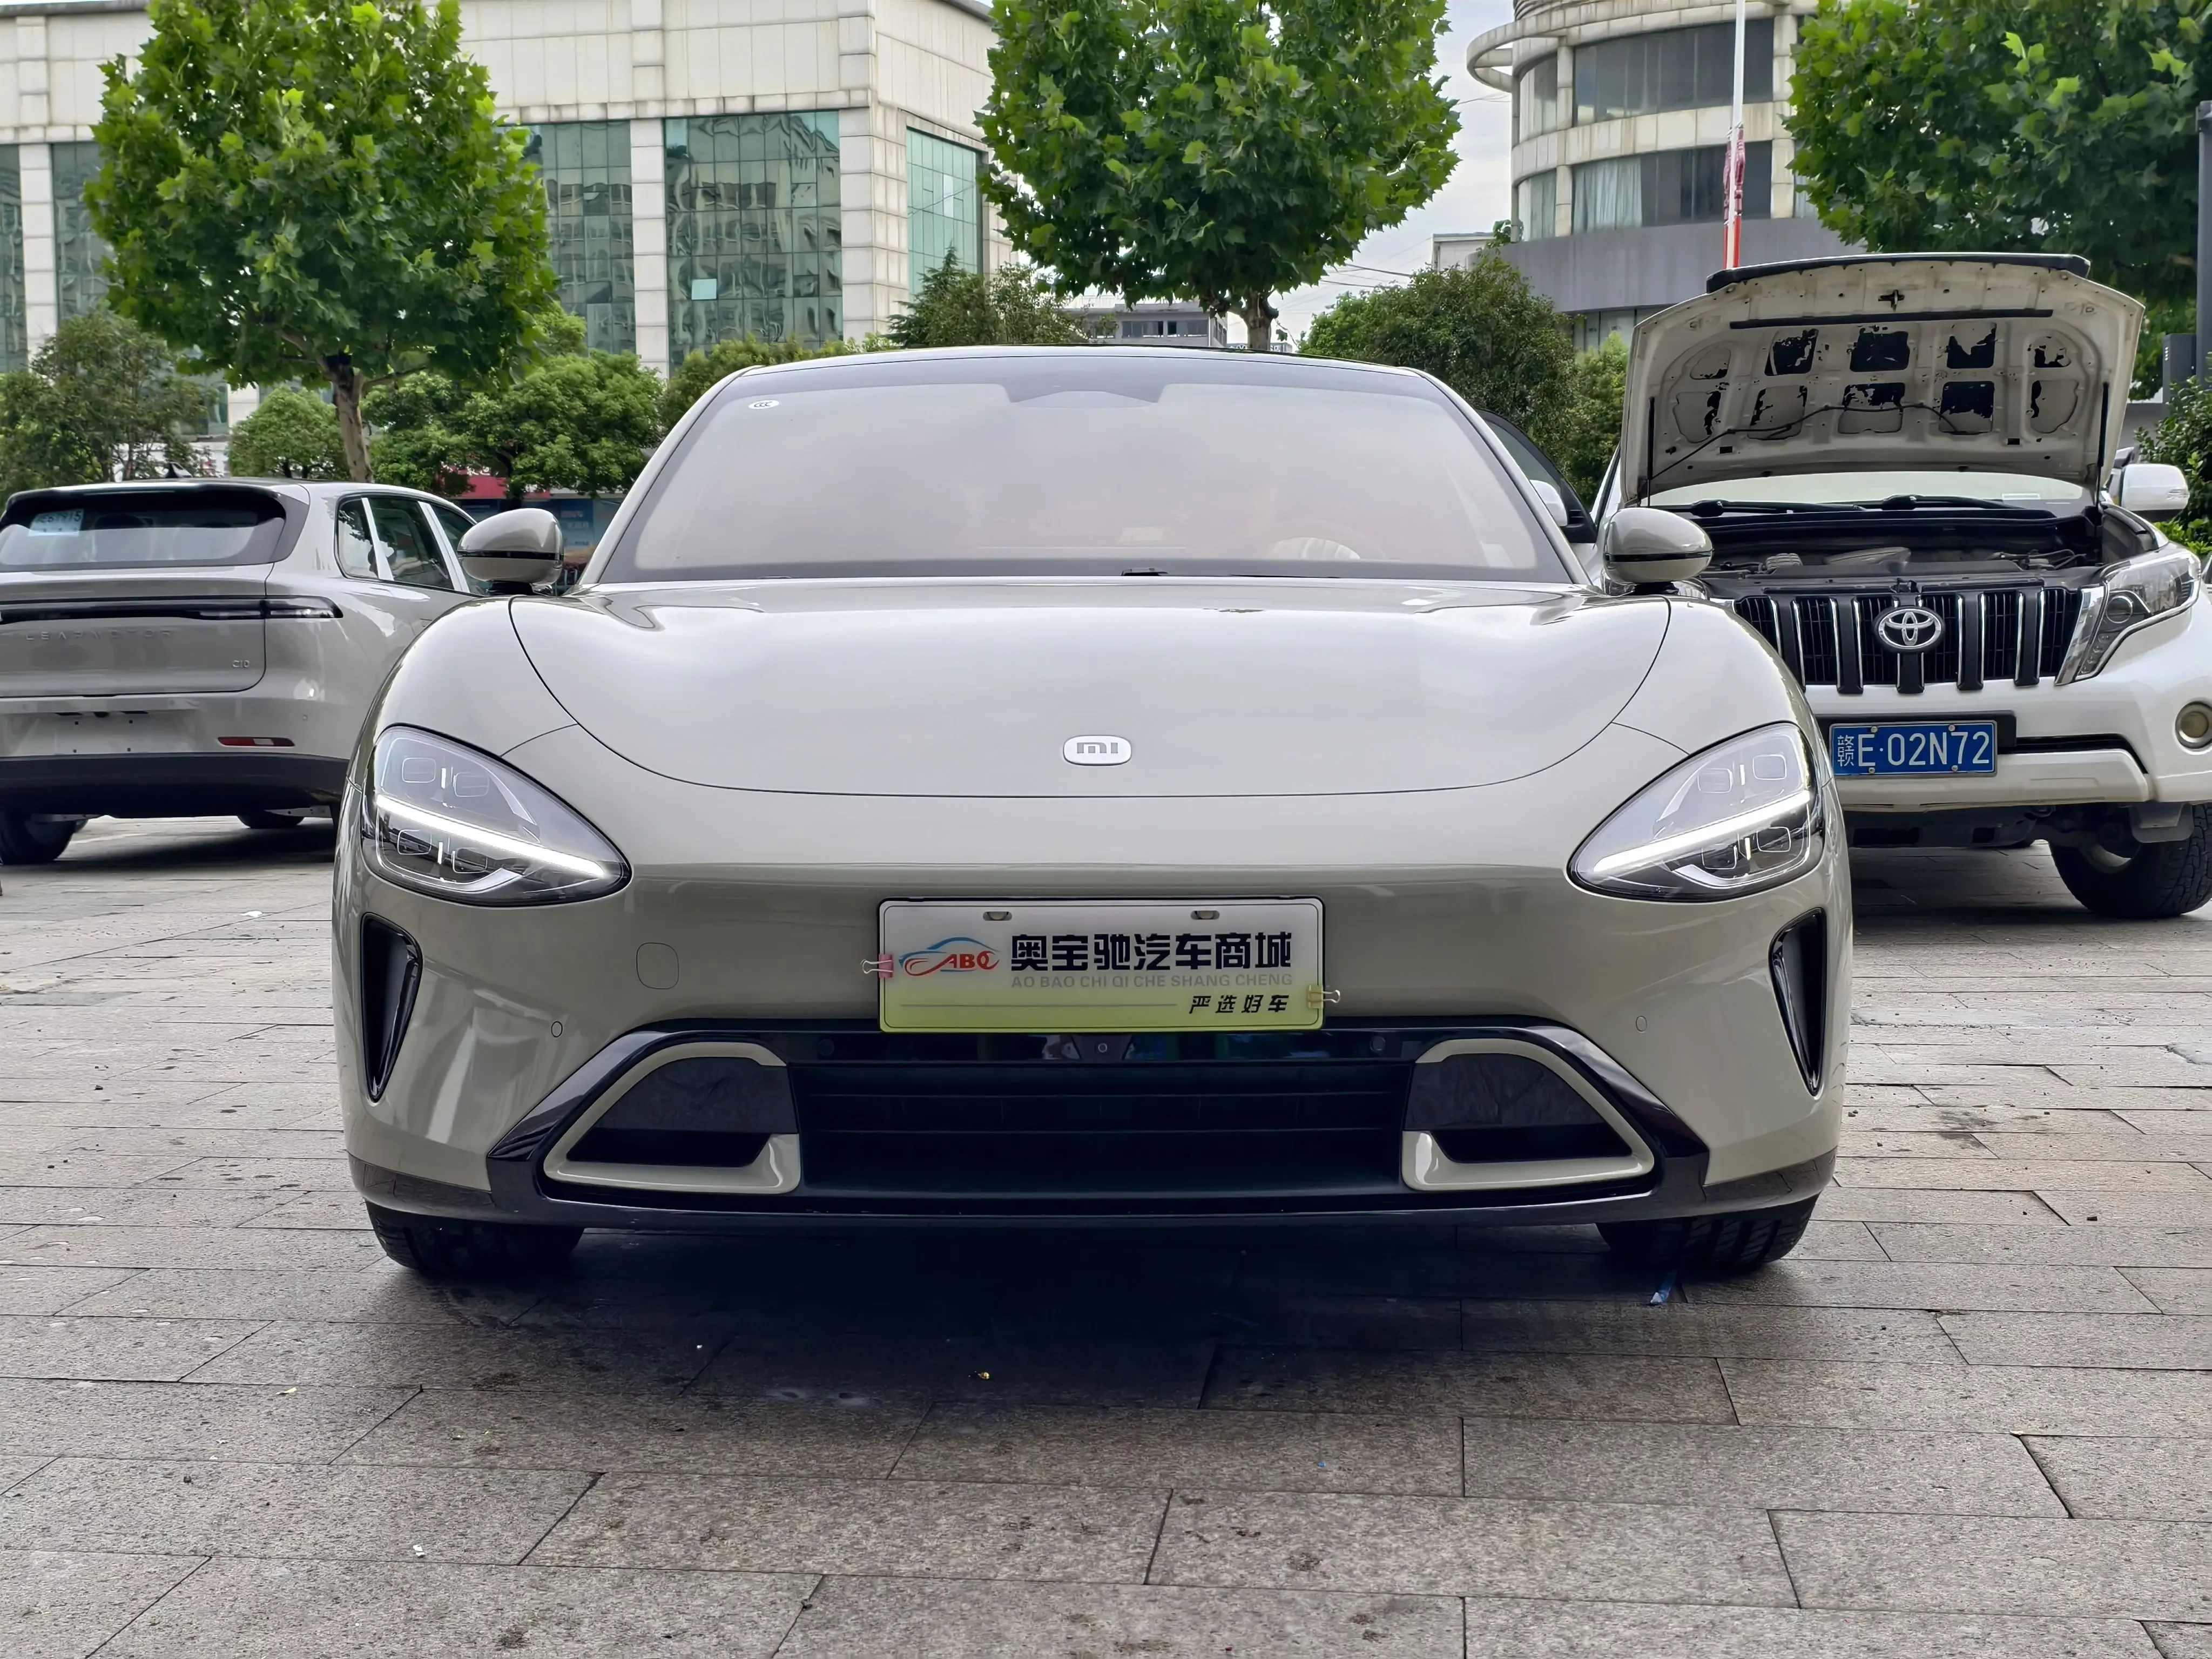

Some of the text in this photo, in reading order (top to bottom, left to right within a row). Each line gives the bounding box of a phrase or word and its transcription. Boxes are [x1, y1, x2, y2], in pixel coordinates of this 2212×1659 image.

[1011, 932, 1292, 971] 奥宝驰汽车商城
[1011, 973, 1293, 988] AO BAO CHI QI CHE SHANG CHENG
[1189, 994, 1290, 1014] 严选好车
